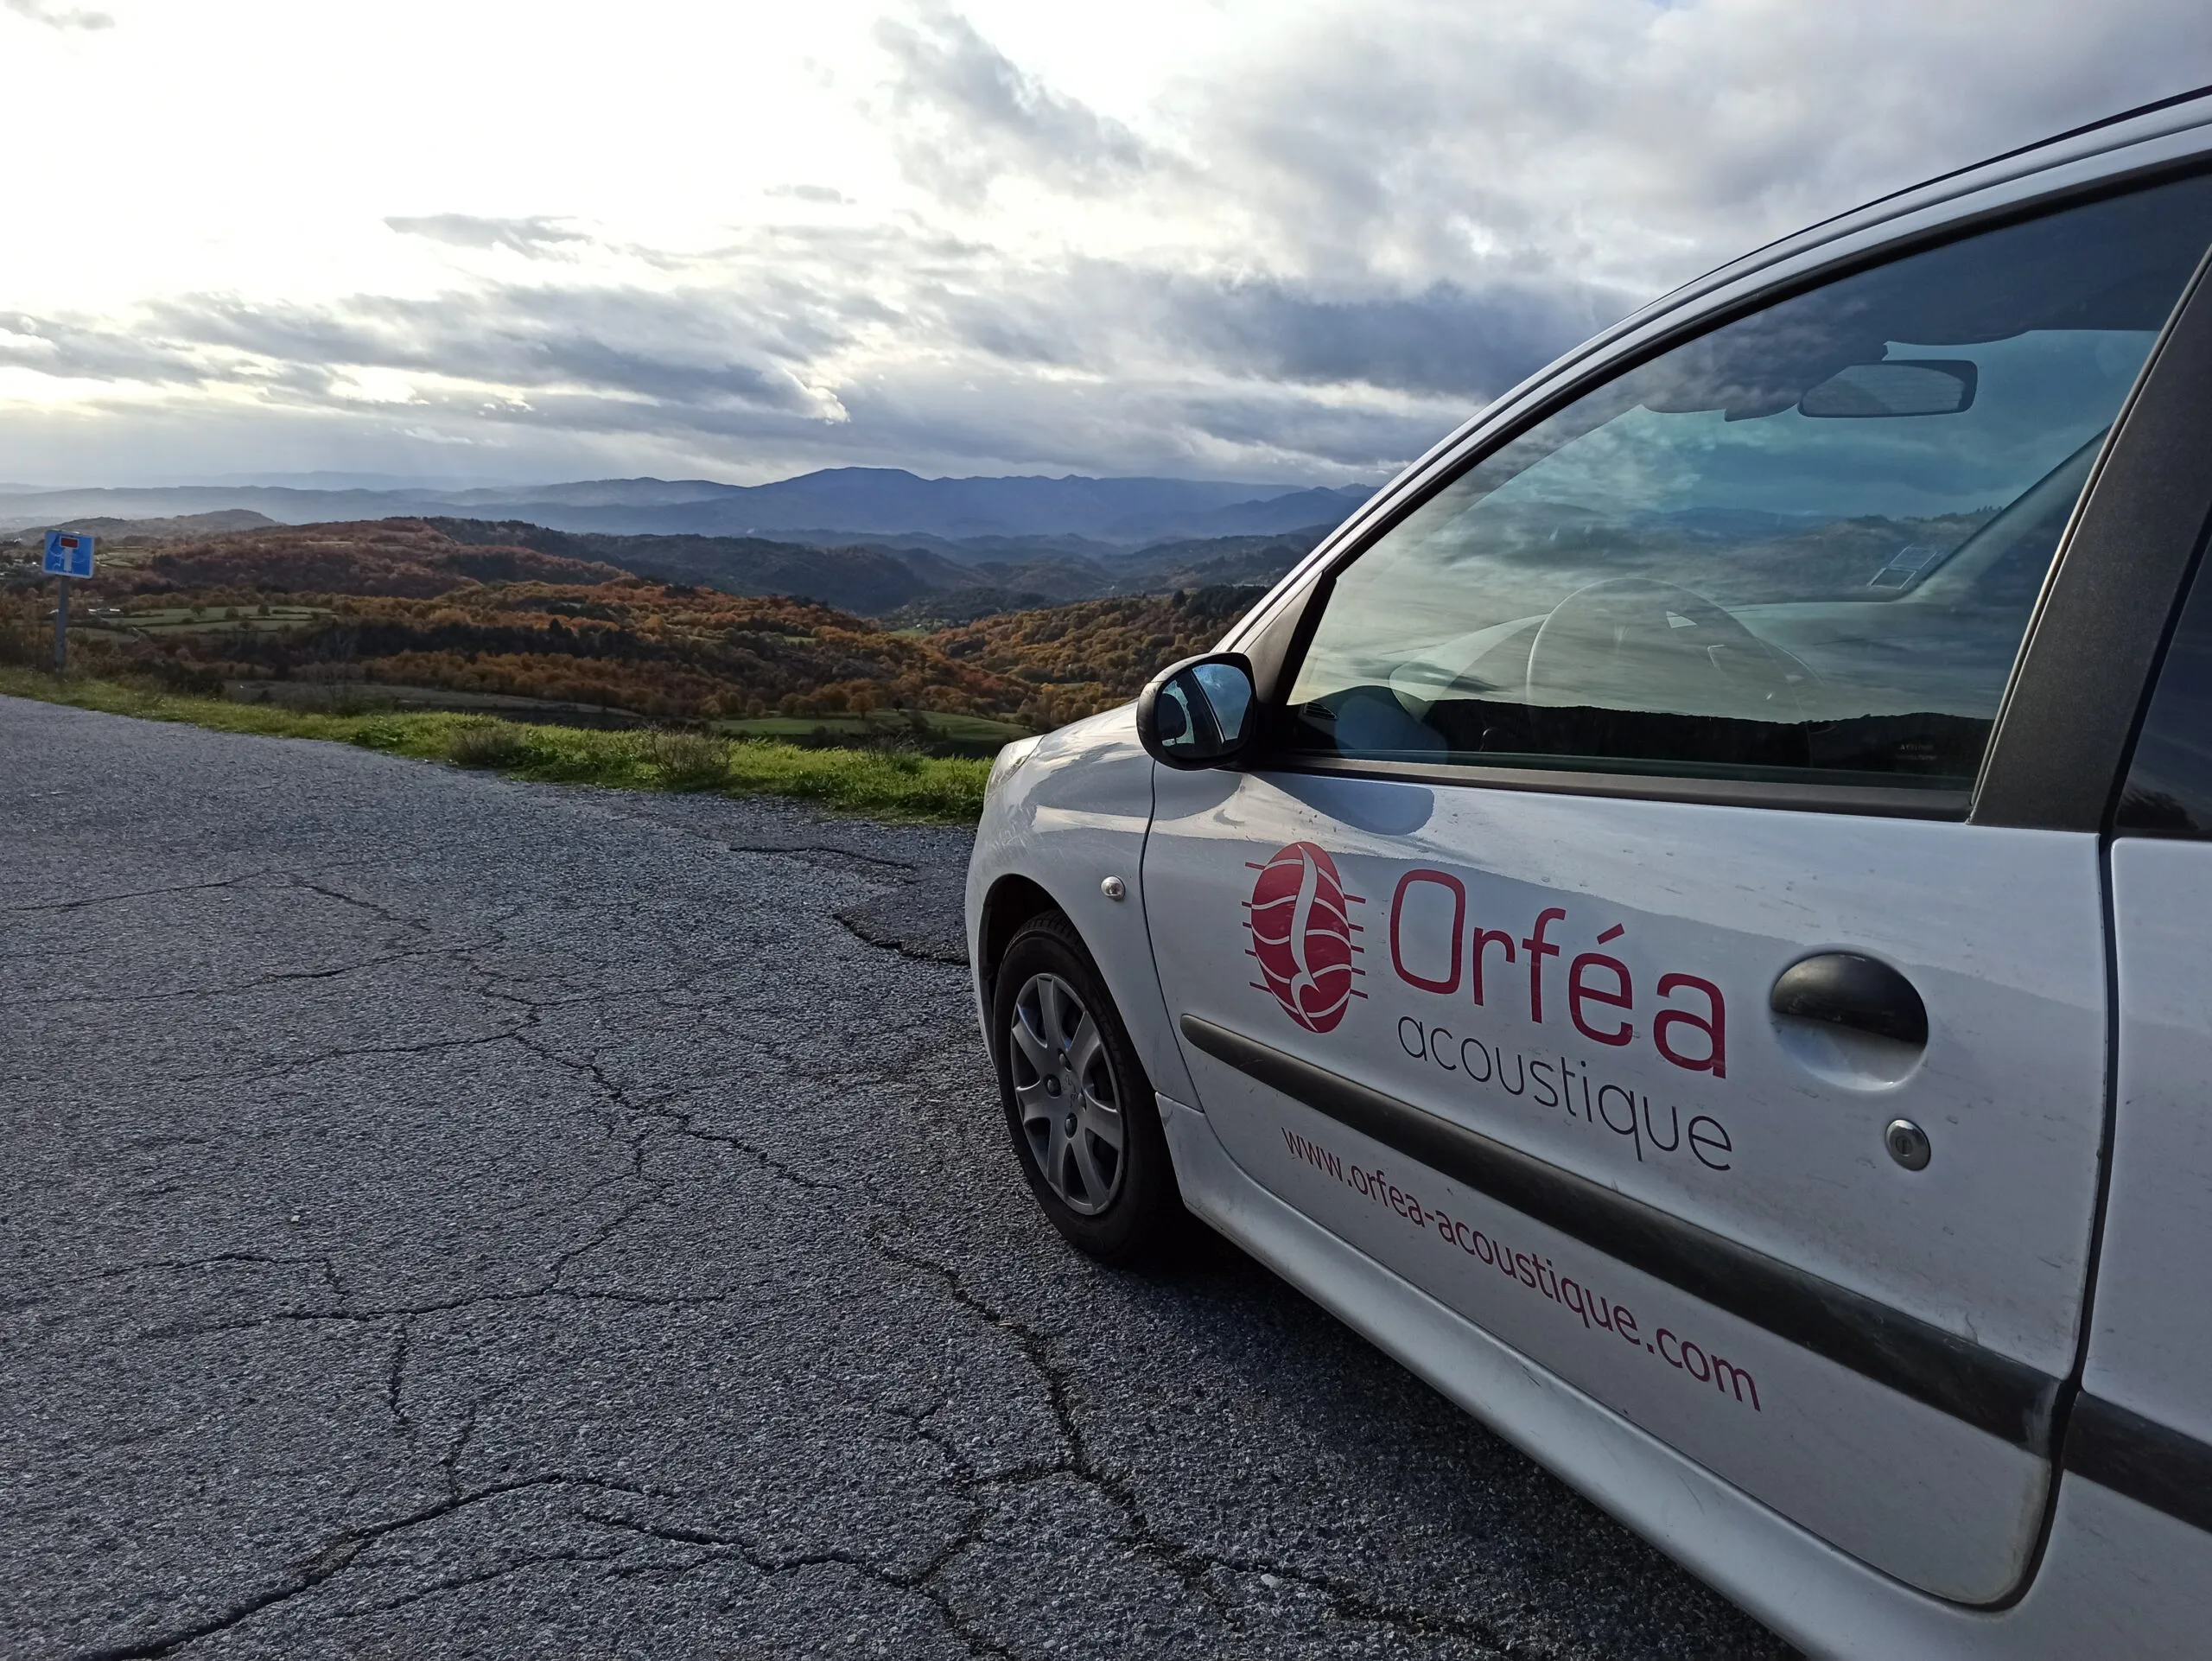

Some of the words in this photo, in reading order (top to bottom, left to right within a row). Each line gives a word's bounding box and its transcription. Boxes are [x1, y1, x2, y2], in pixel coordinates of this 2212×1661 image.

[1390, 869, 1726, 1079] Orféa
[1397, 1015, 1732, 1171] acoustique
[1281, 1127, 1761, 1412] www.orfea-acoustique.com
